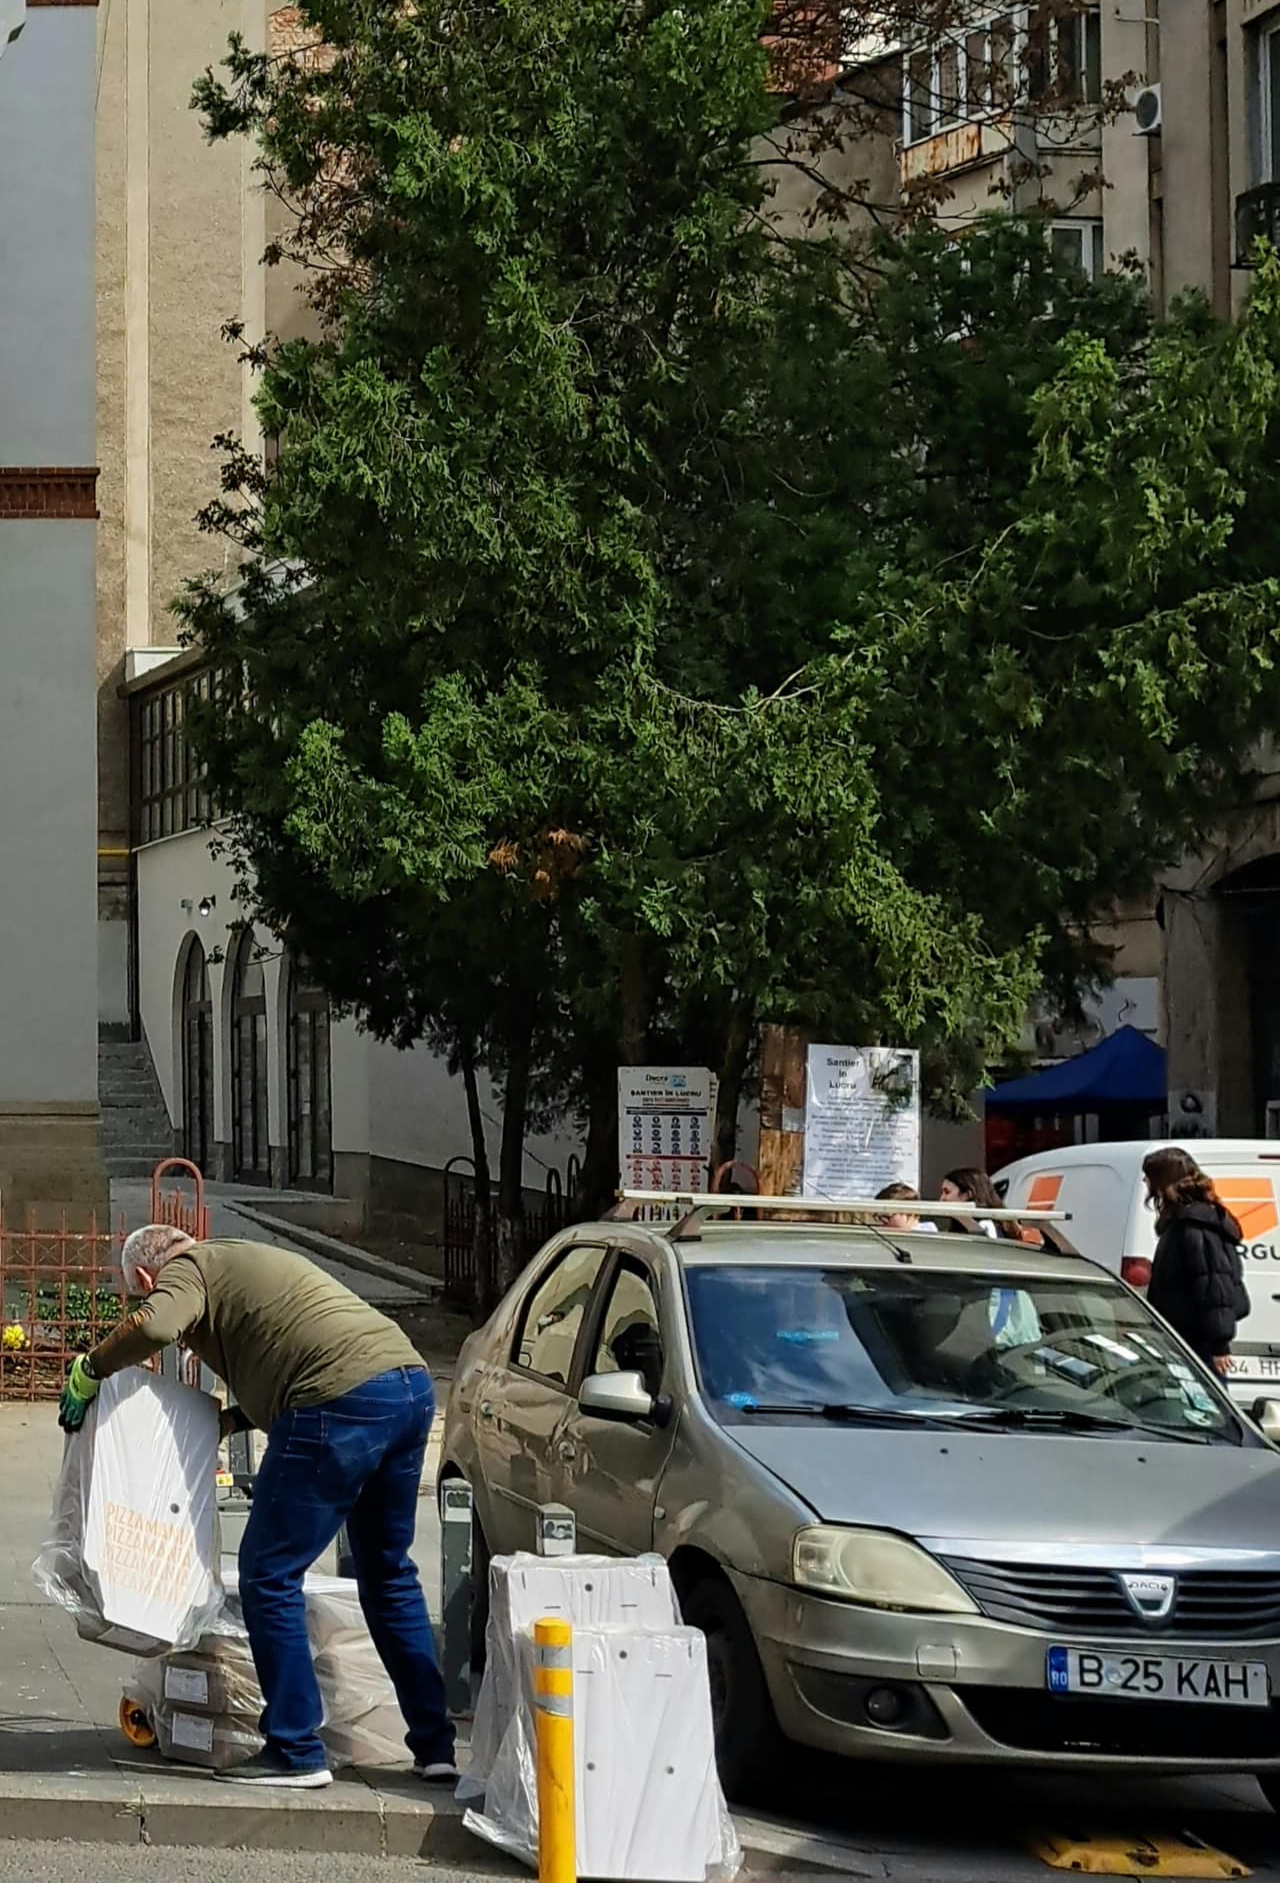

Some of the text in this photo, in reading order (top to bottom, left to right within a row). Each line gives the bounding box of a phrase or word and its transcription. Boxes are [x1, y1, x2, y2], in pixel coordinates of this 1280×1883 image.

[1052, 1654, 1249, 1699] RO B 25 KAH
